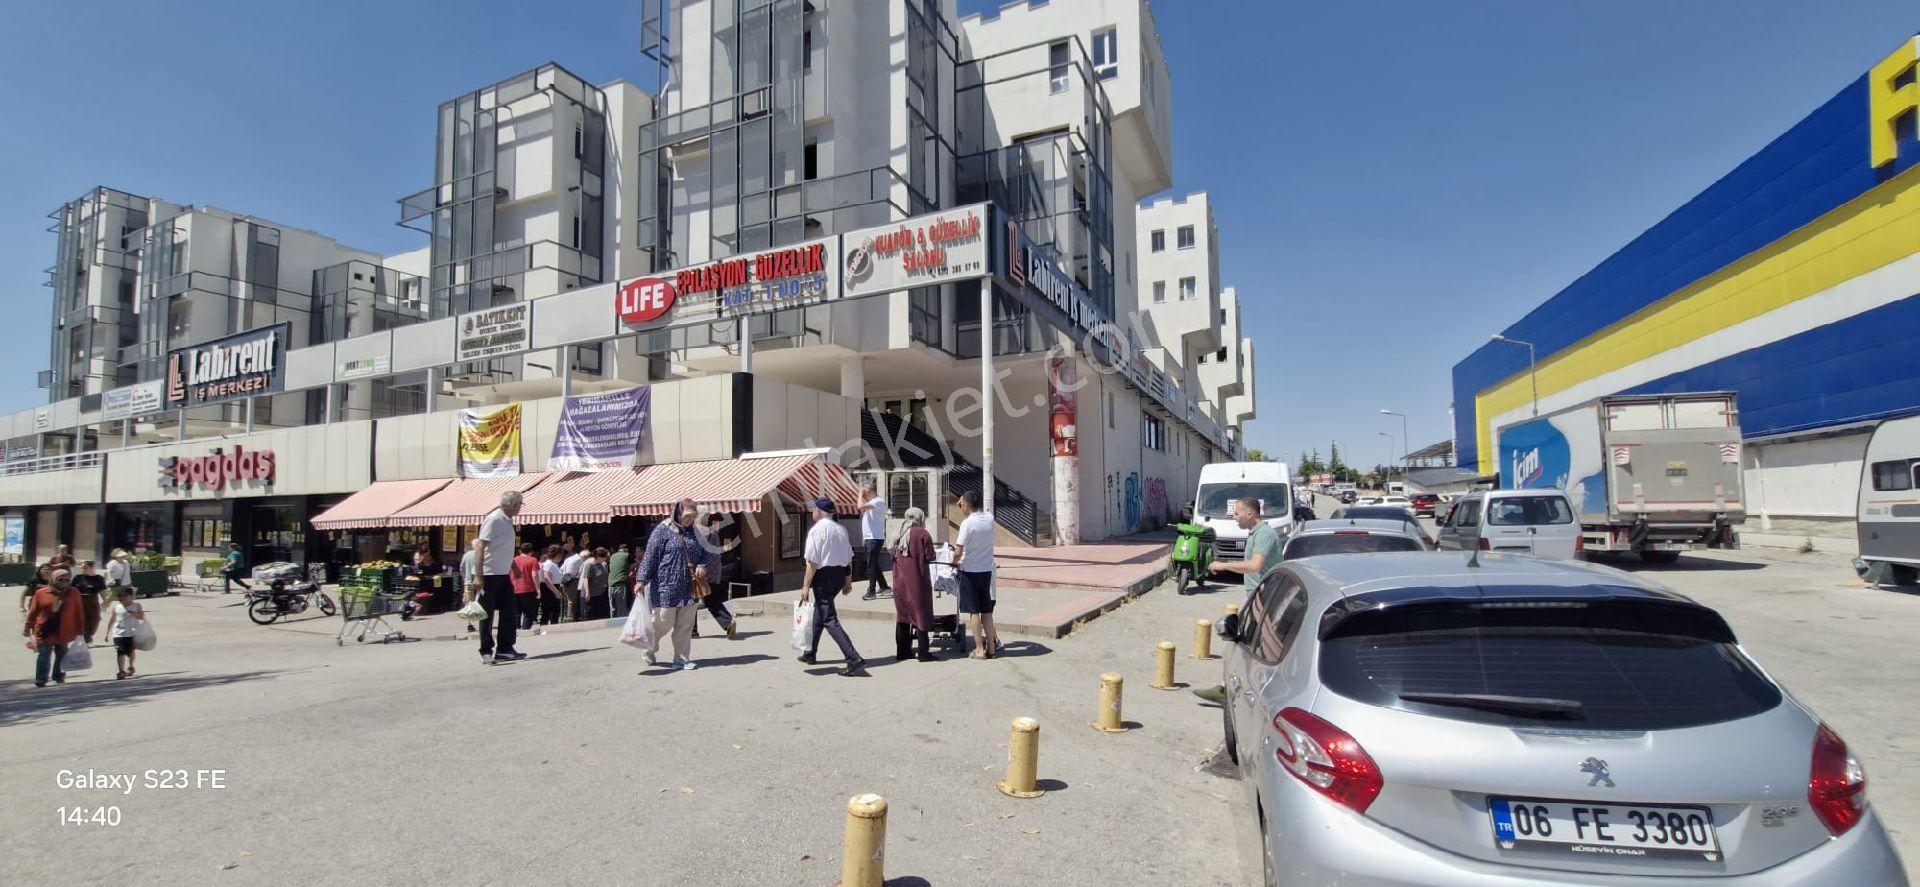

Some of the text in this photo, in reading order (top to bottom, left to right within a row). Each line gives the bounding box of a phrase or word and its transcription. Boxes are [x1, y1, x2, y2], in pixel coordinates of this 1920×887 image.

[874, 211, 980, 254] KUAFÖR & GÜZELLİK
[676, 257, 748, 297] EPİLASYON
[755, 243, 825, 281] GÜZELLİK
[902, 246, 945, 272] SALONU
[621, 282, 665, 315] LIFE
[1027, 246, 1070, 317] Labirent
[188, 330, 276, 386] Labirent
[1498, 822, 1513, 832] TR
[1514, 804, 1707, 846] 06 FE 3380
